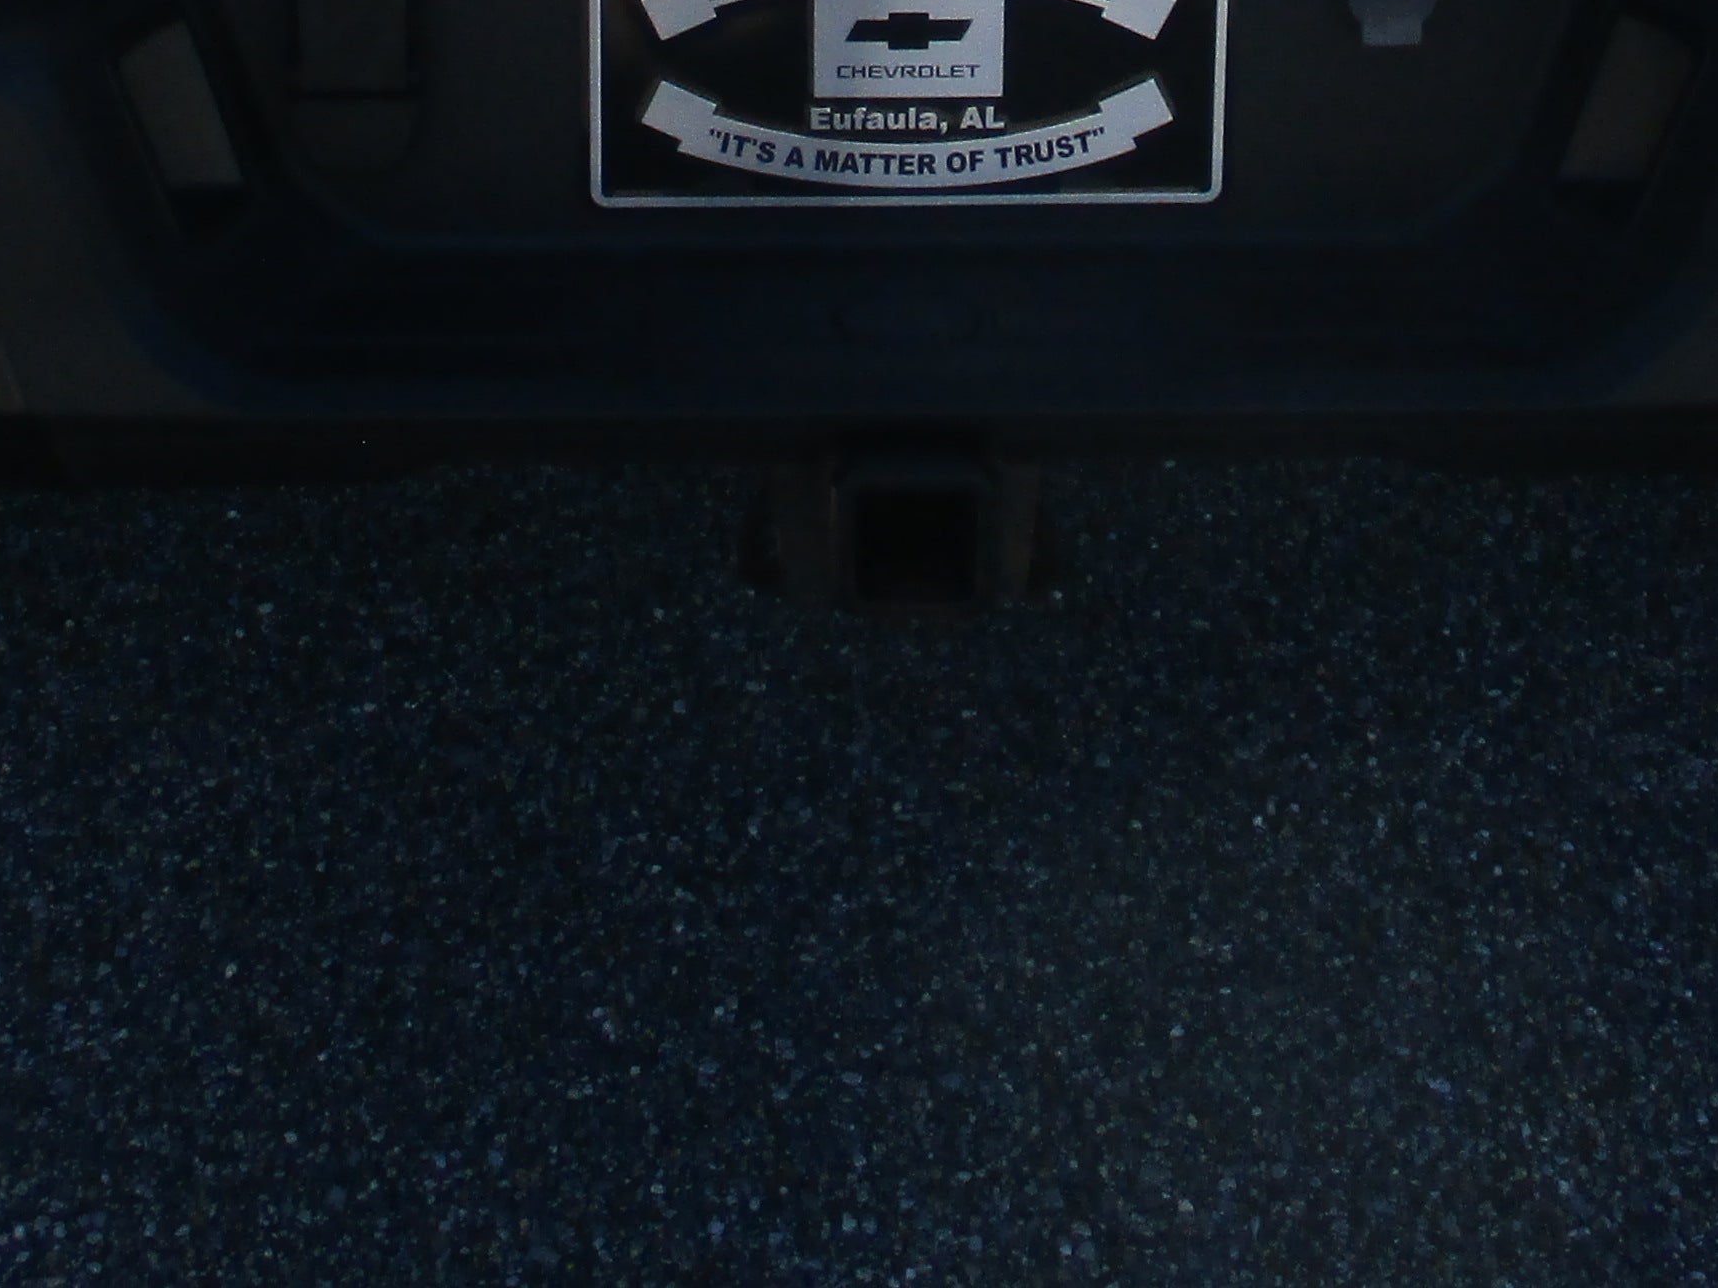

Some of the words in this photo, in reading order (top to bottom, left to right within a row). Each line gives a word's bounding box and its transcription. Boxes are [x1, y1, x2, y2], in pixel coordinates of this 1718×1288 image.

[835, 63, 981, 80] CHEVROLET
[809, 105, 949, 135] Eufaula,
[959, 107, 1005, 130] AL
[708, 127, 777, 164] "IT'S
[784, 147, 805, 169] A
[813, 149, 937, 176] MATTER
[945, 149, 986, 175] OF
[993, 126, 1108, 172] TRUST"
